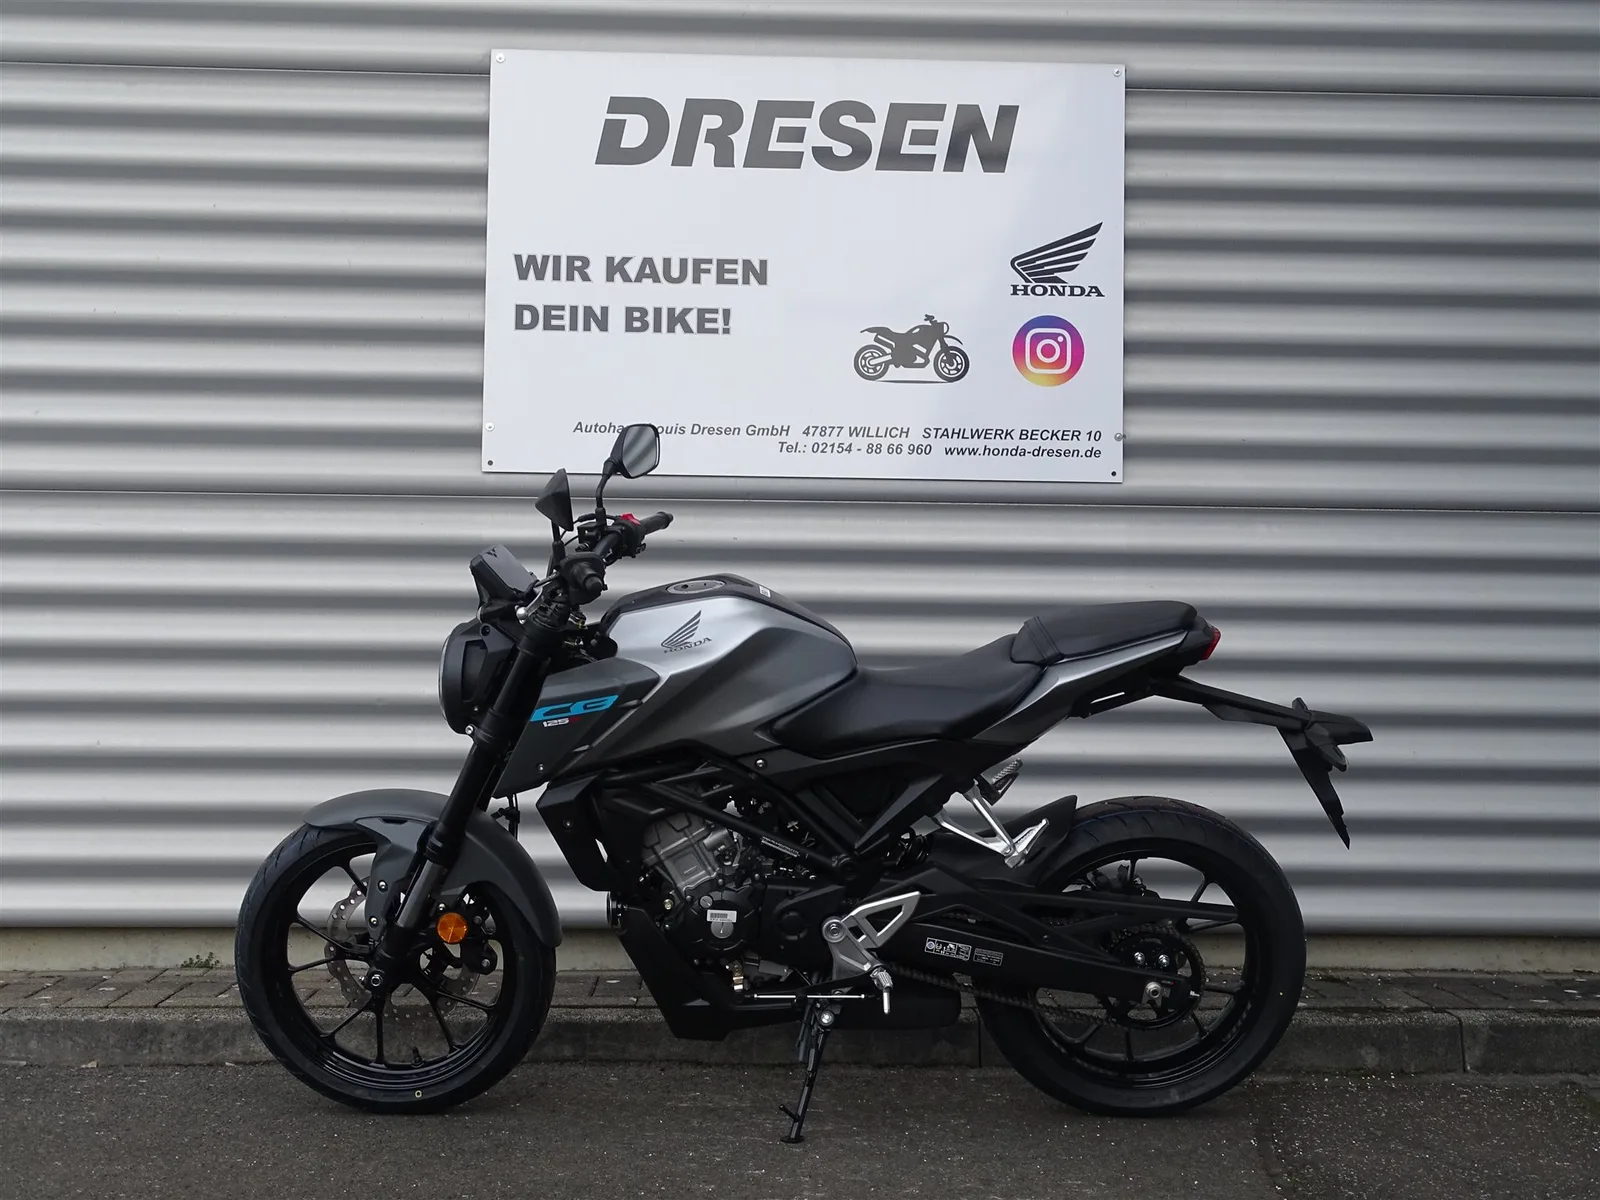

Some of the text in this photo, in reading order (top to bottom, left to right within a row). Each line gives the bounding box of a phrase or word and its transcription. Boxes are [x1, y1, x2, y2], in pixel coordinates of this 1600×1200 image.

[595, 95, 1020, 174] DRESEN
[513, 253, 768, 286] WIR KAUFEN
[1010, 284, 1106, 298] HONDA
[514, 303, 731, 335] DEIN BIKE!
[573, 421, 1102, 441] Autoha ouis Dresen GmbH 47877 WILLICH STAHLWERK BECKER 10
[778, 441, 807, 454] Tel.:
[811, 441, 853, 455] 02154
[866, 442, 883, 455] 88
[886, 442, 904, 455] 66
[907, 443, 933, 456] 960
[944, 444, 1102, 459] www.honda-dresen.de
[530, 694, 619, 722] CB
